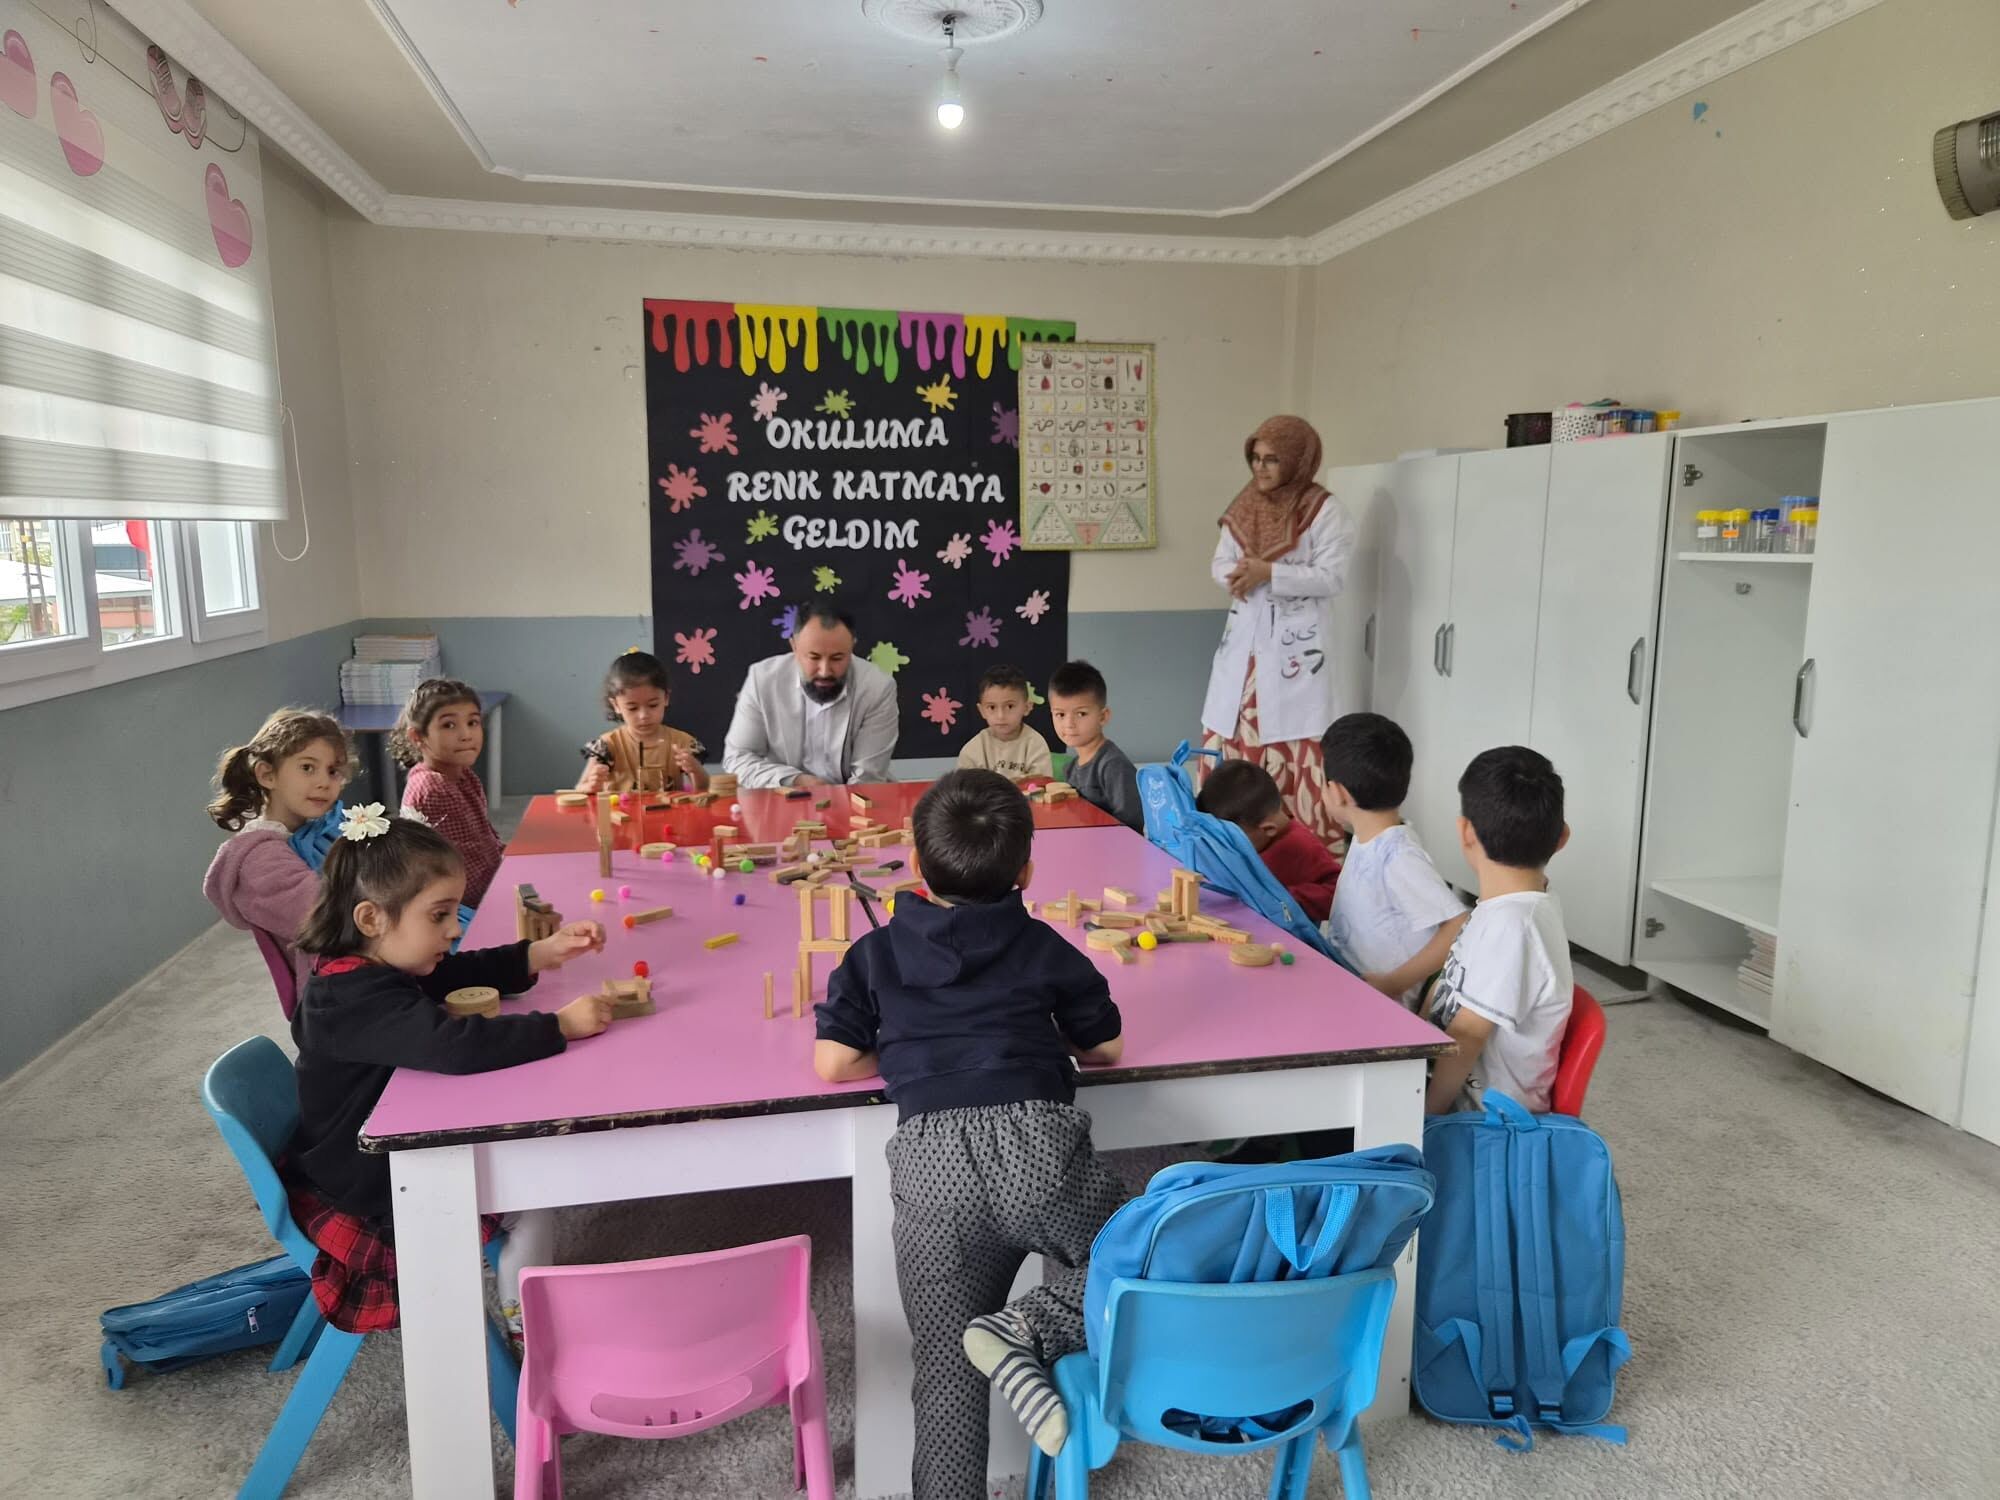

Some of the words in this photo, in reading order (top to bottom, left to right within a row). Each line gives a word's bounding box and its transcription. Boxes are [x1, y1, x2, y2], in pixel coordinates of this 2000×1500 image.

[766, 416, 949, 451] OKULUMA
[726, 470, 822, 502] RENK
[832, 470, 1005, 503] KATMAYA
[783, 515, 920, 551] GELDIM
